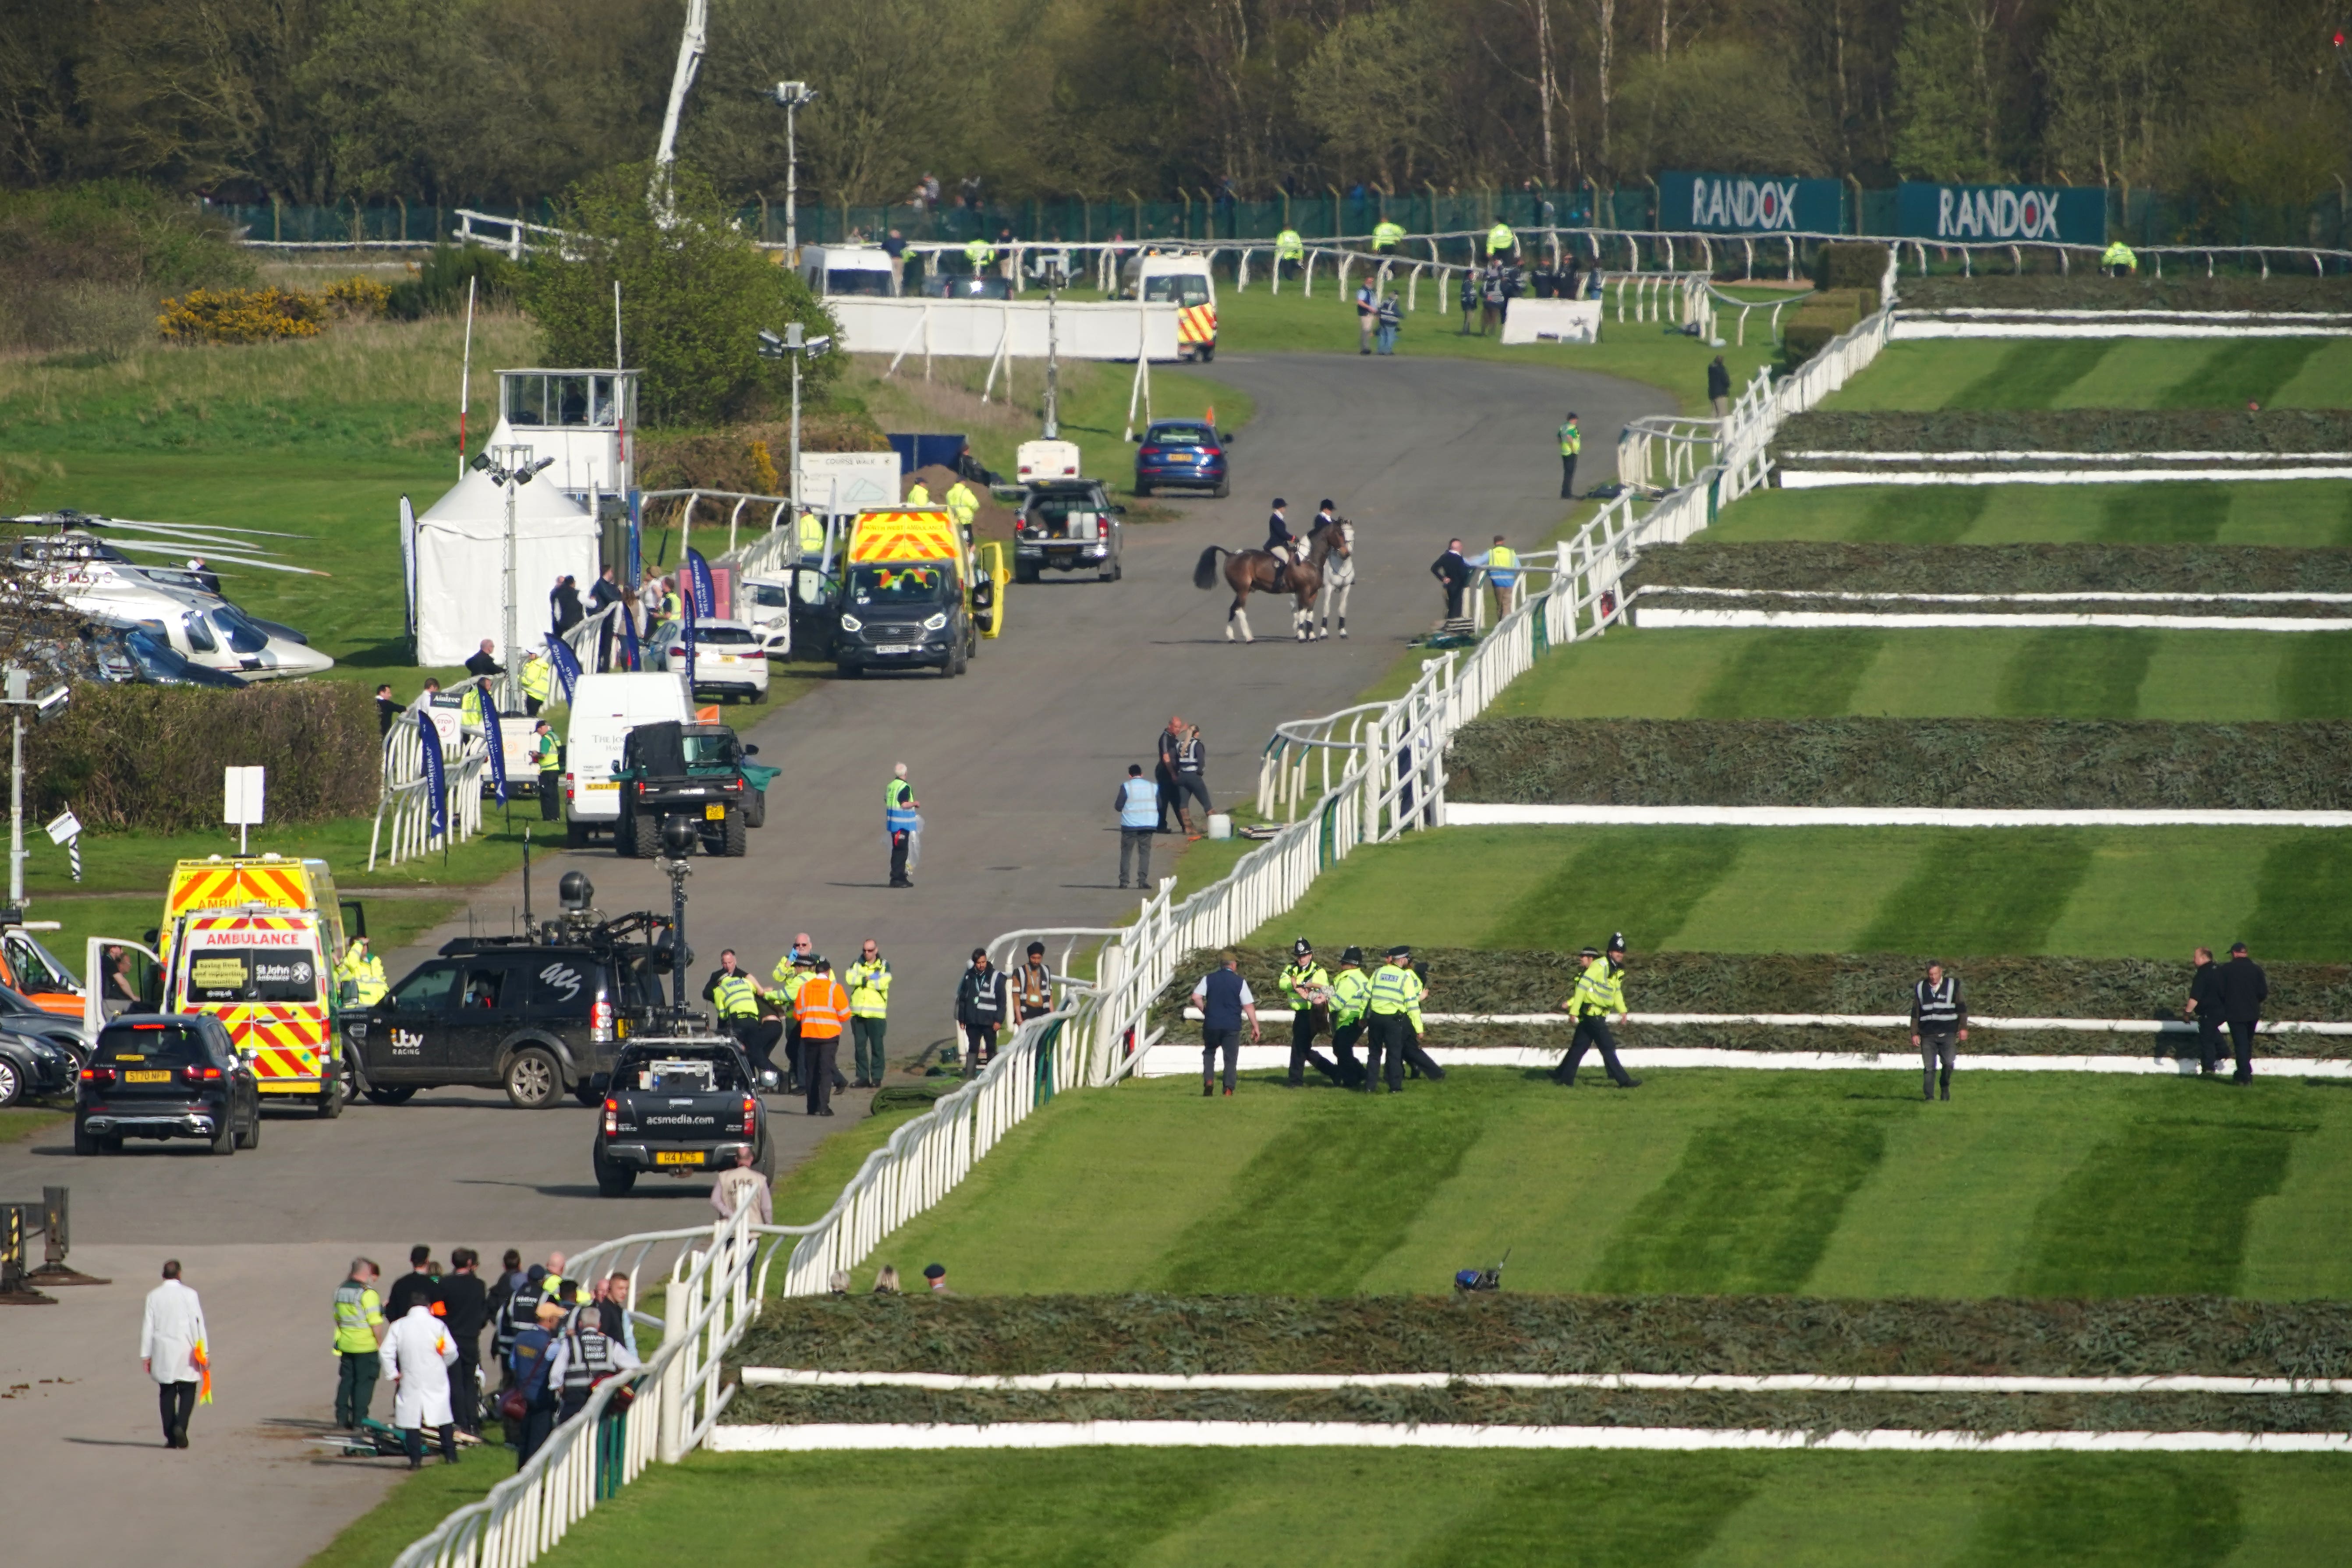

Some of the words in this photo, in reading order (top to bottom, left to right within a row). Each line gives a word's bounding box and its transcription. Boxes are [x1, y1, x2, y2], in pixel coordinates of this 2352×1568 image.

[1692, 177, 1797, 229] RANDOX
[1938, 188, 2060, 239] RANDOX
[592, 735, 609, 743] THE
[207, 934, 299, 945] AMBULANCE
[267, 964, 290, 976] John
[390, 1028, 424, 1048] itv
[646, 1114, 714, 1125] acsmedia.com
